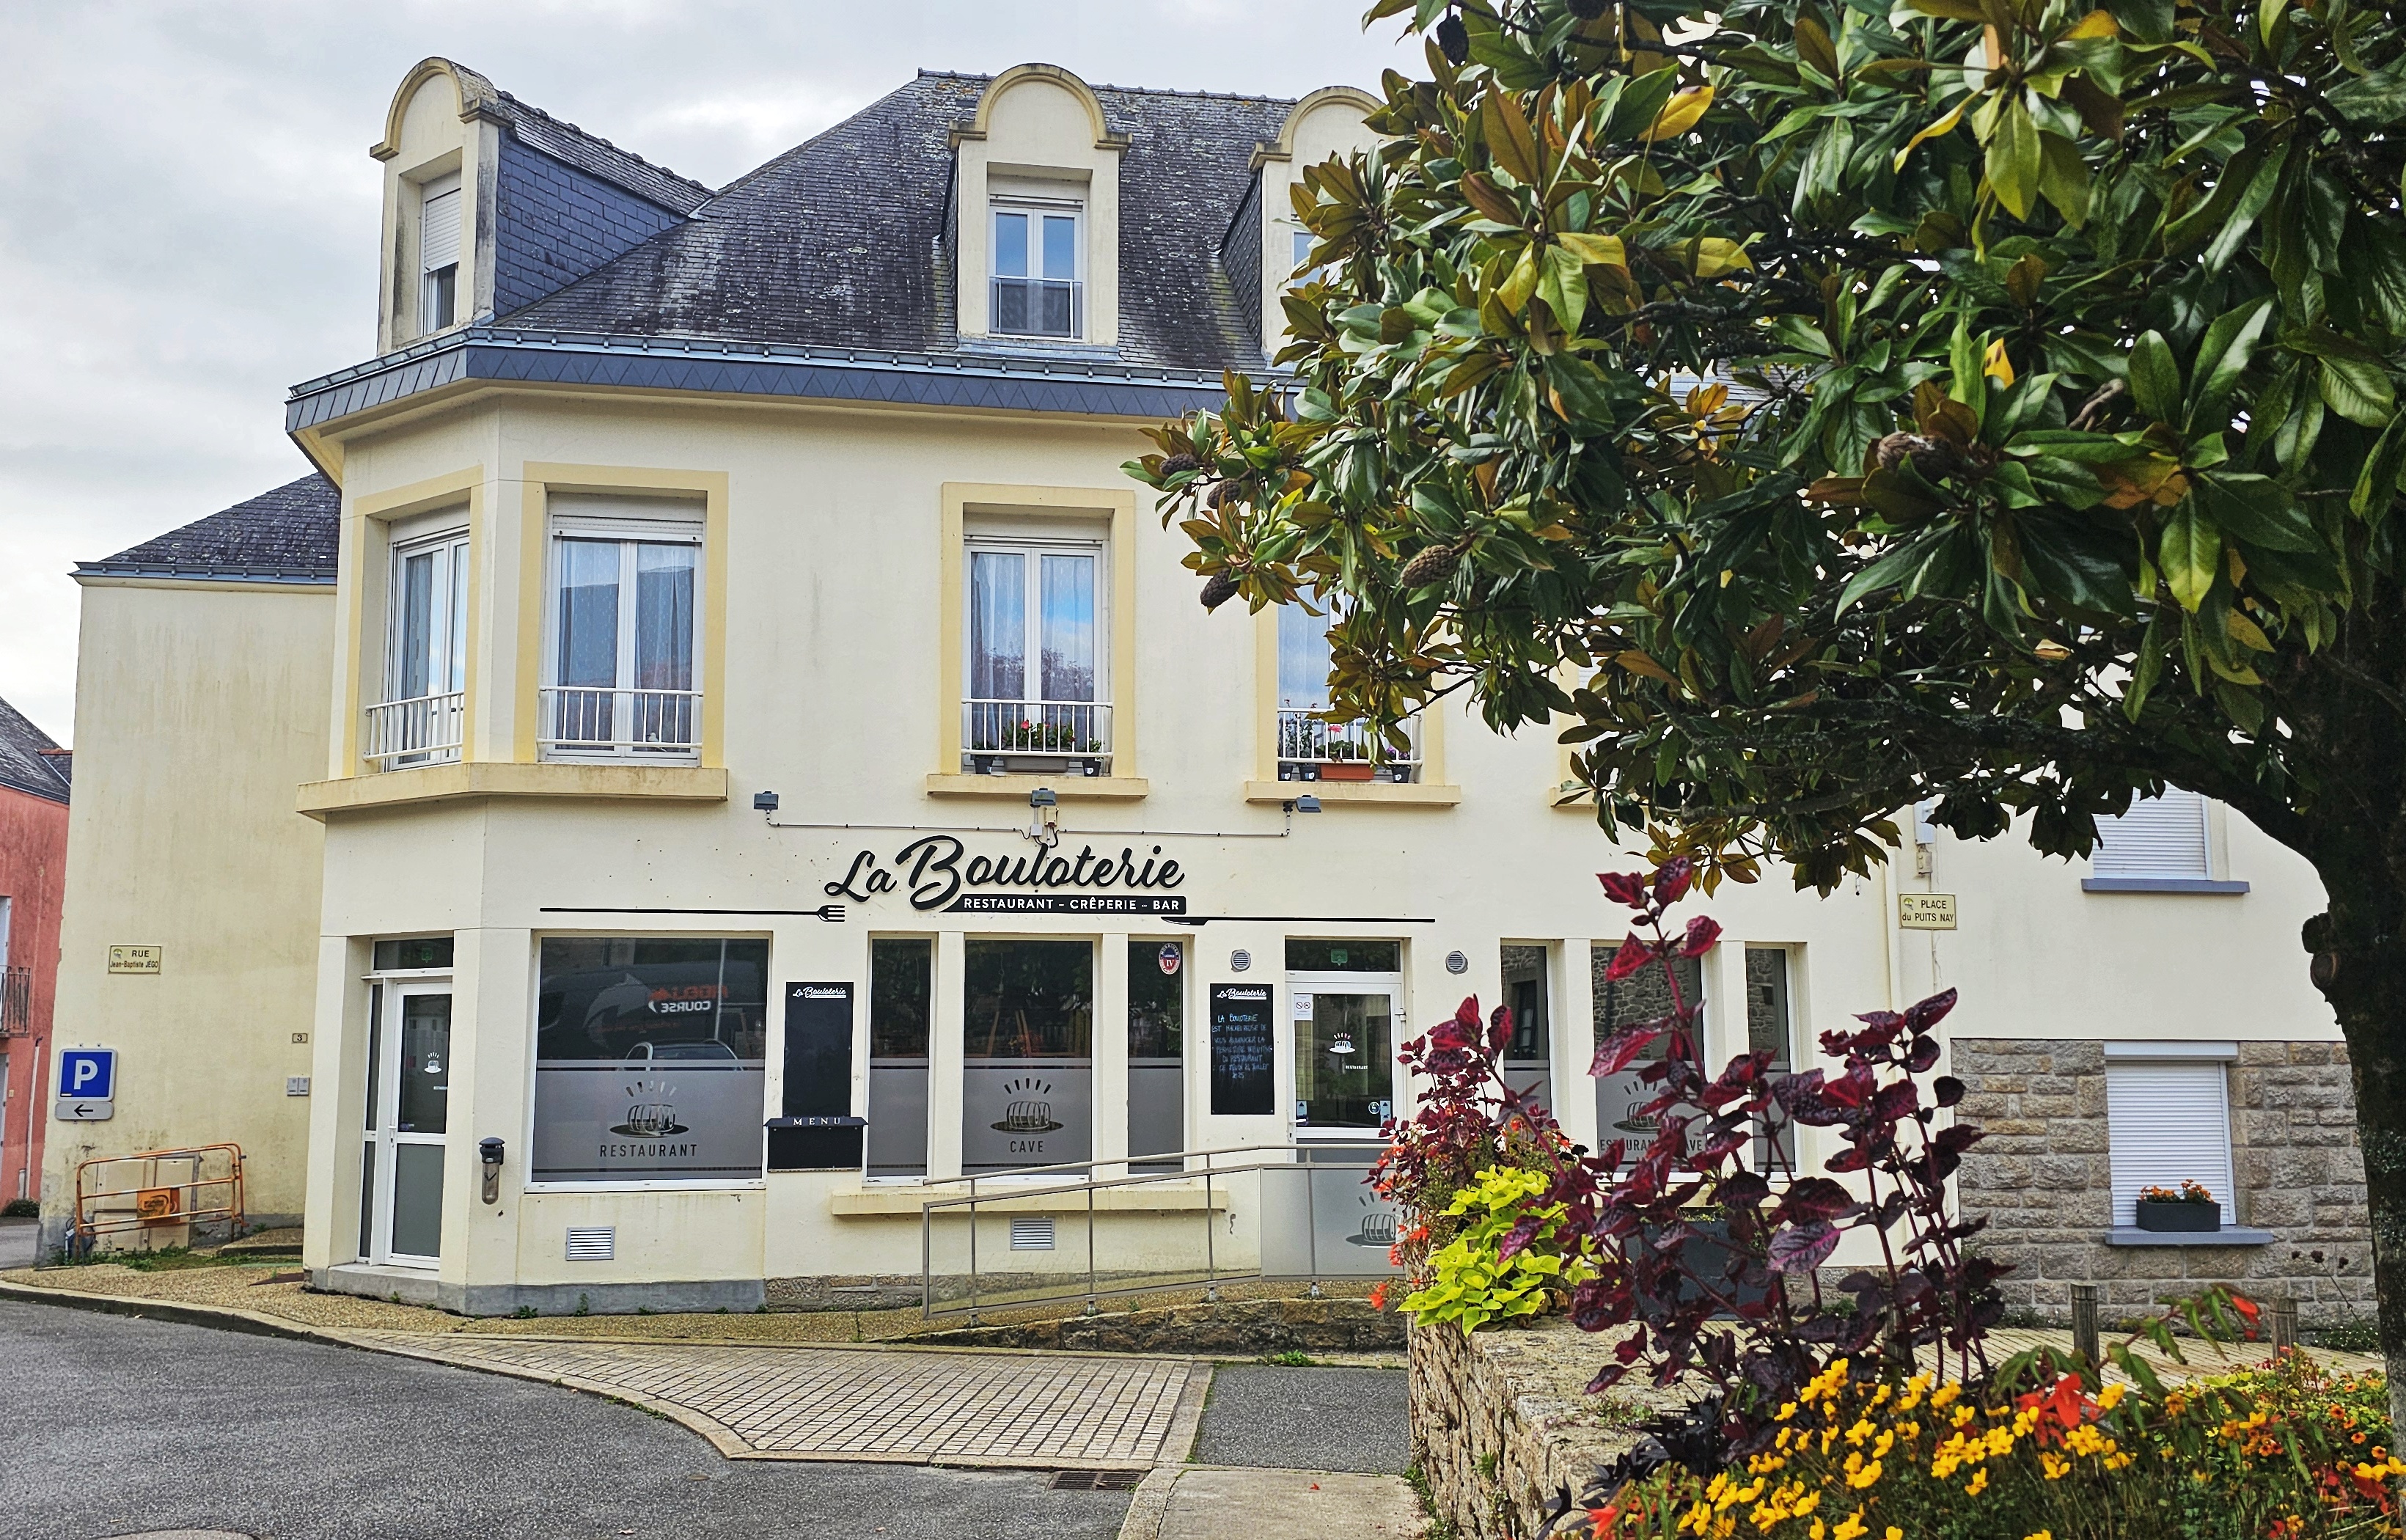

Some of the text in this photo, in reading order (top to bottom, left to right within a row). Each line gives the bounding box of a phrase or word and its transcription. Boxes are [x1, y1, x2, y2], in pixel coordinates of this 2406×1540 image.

[824, 835, 1185, 911] La Bouloterie
[964, 898, 1054, 909] RESTAURANT
[1070, 897, 1137, 909] CRÊPERIE
[1153, 900, 1179, 910] BAR
[1921, 900, 1947, 909] PLACE
[1902, 912, 1954, 922] du PUITS NAY
[793, 989, 804, 997] La
[1217, 990, 1227, 998] La
[73, 1059, 98, 1090] P
[793, 1117, 841, 1126] MENU
[600, 1144, 697, 1158] RESTAURANT
[1010, 1140, 1044, 1153] CAVE
